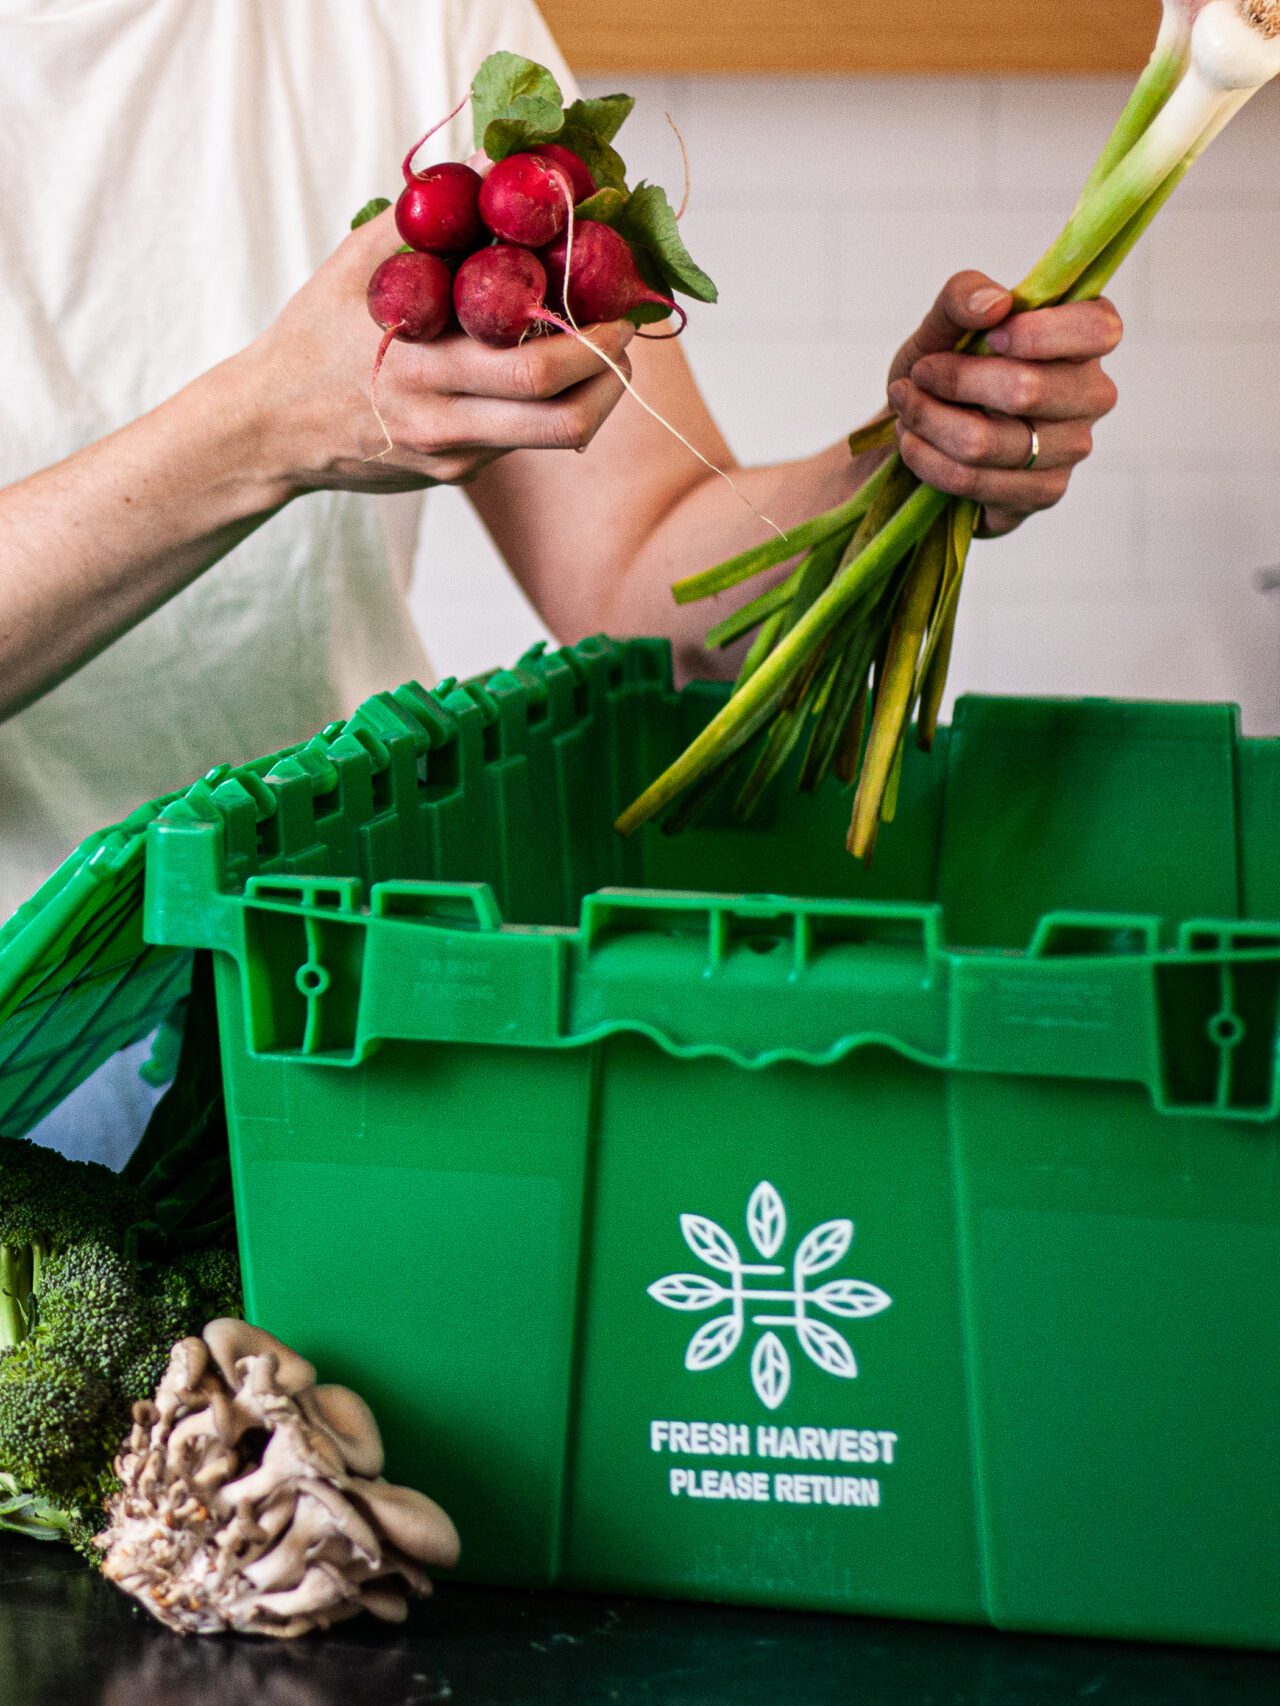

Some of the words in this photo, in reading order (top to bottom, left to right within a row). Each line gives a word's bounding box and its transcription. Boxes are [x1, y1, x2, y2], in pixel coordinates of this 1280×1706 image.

[651, 1419, 750, 1456] FRESH
[756, 1425, 898, 1465] HARVEST
[670, 1468, 771, 1502] PLEASE
[773, 1473, 881, 1508] RETURN
